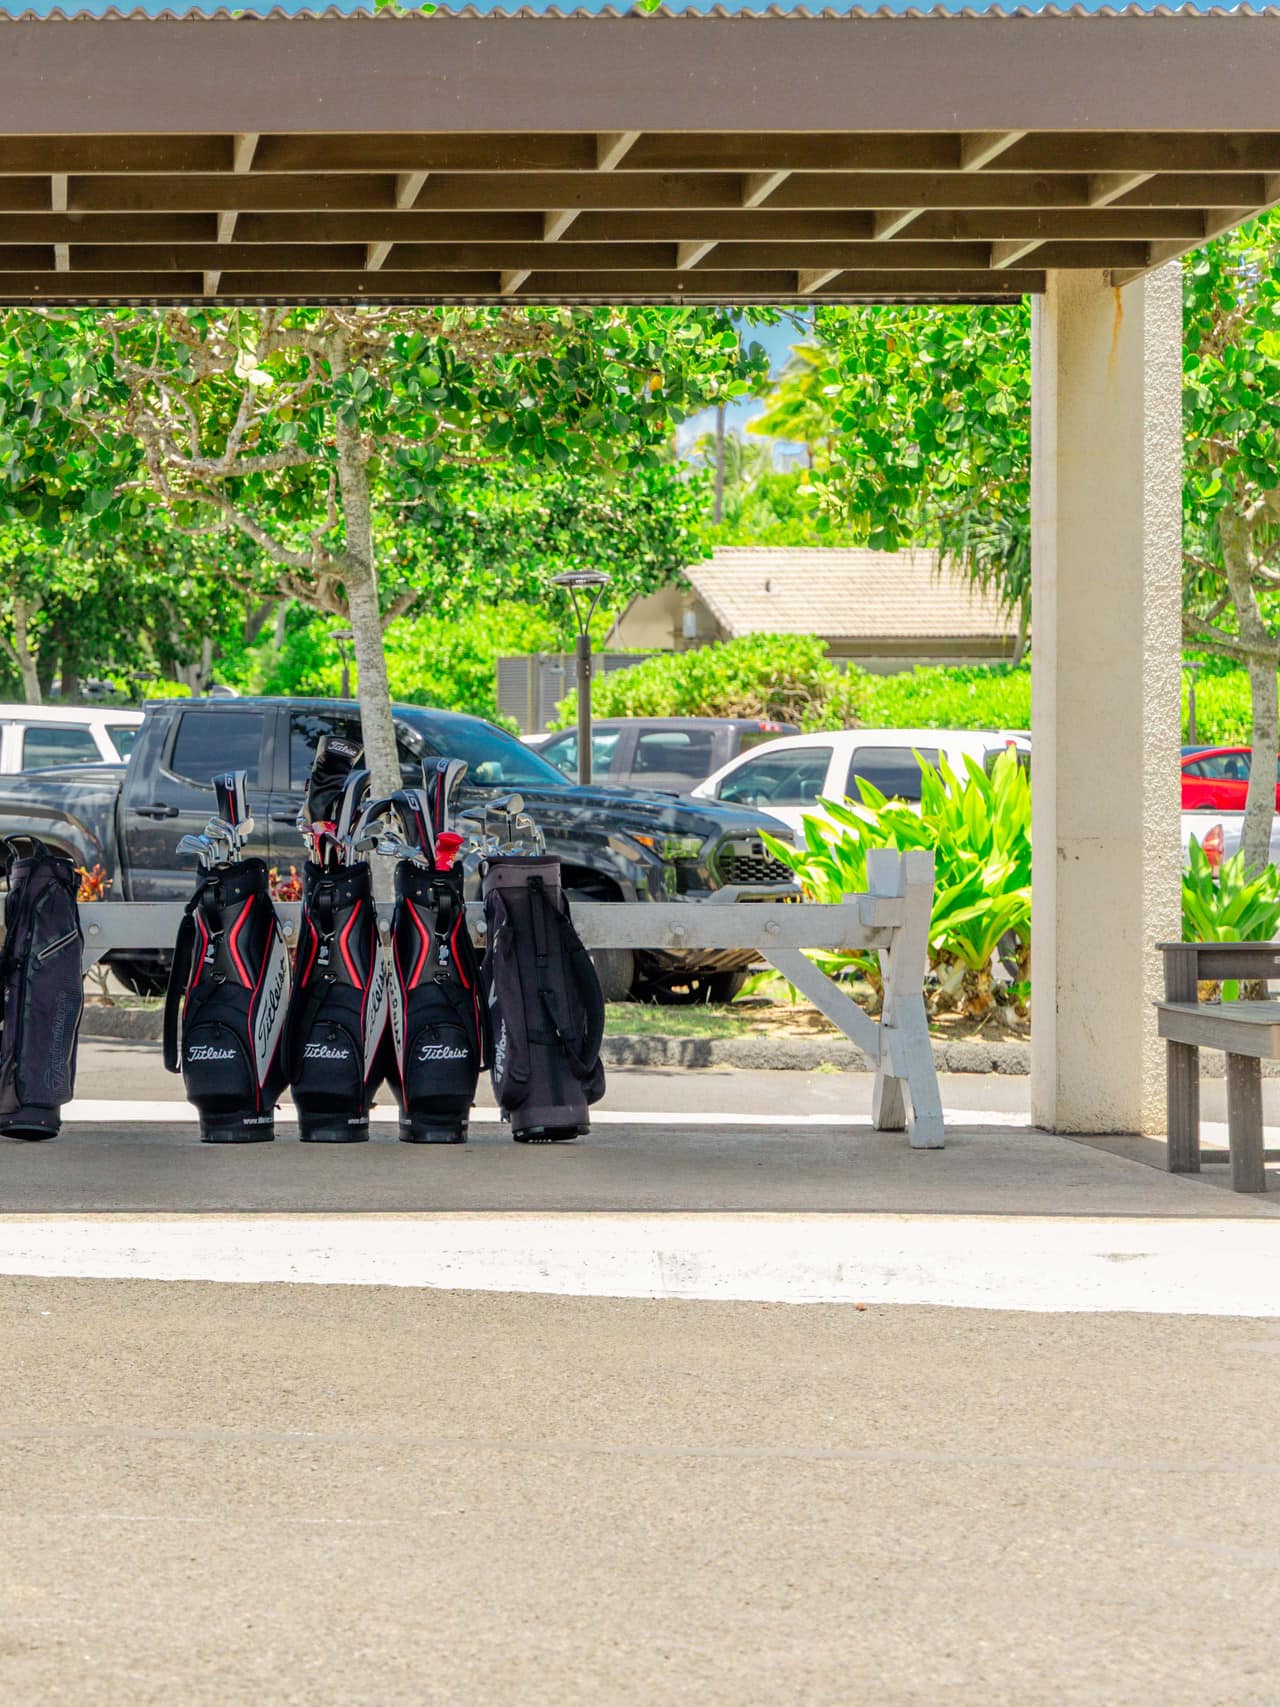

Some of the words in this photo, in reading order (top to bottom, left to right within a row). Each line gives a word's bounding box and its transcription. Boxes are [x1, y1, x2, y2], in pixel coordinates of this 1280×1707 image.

[187, 1045, 237, 1062] Titleist
[303, 1043, 350, 1060] Titleist
[418, 1044, 469, 1061] Titleist
